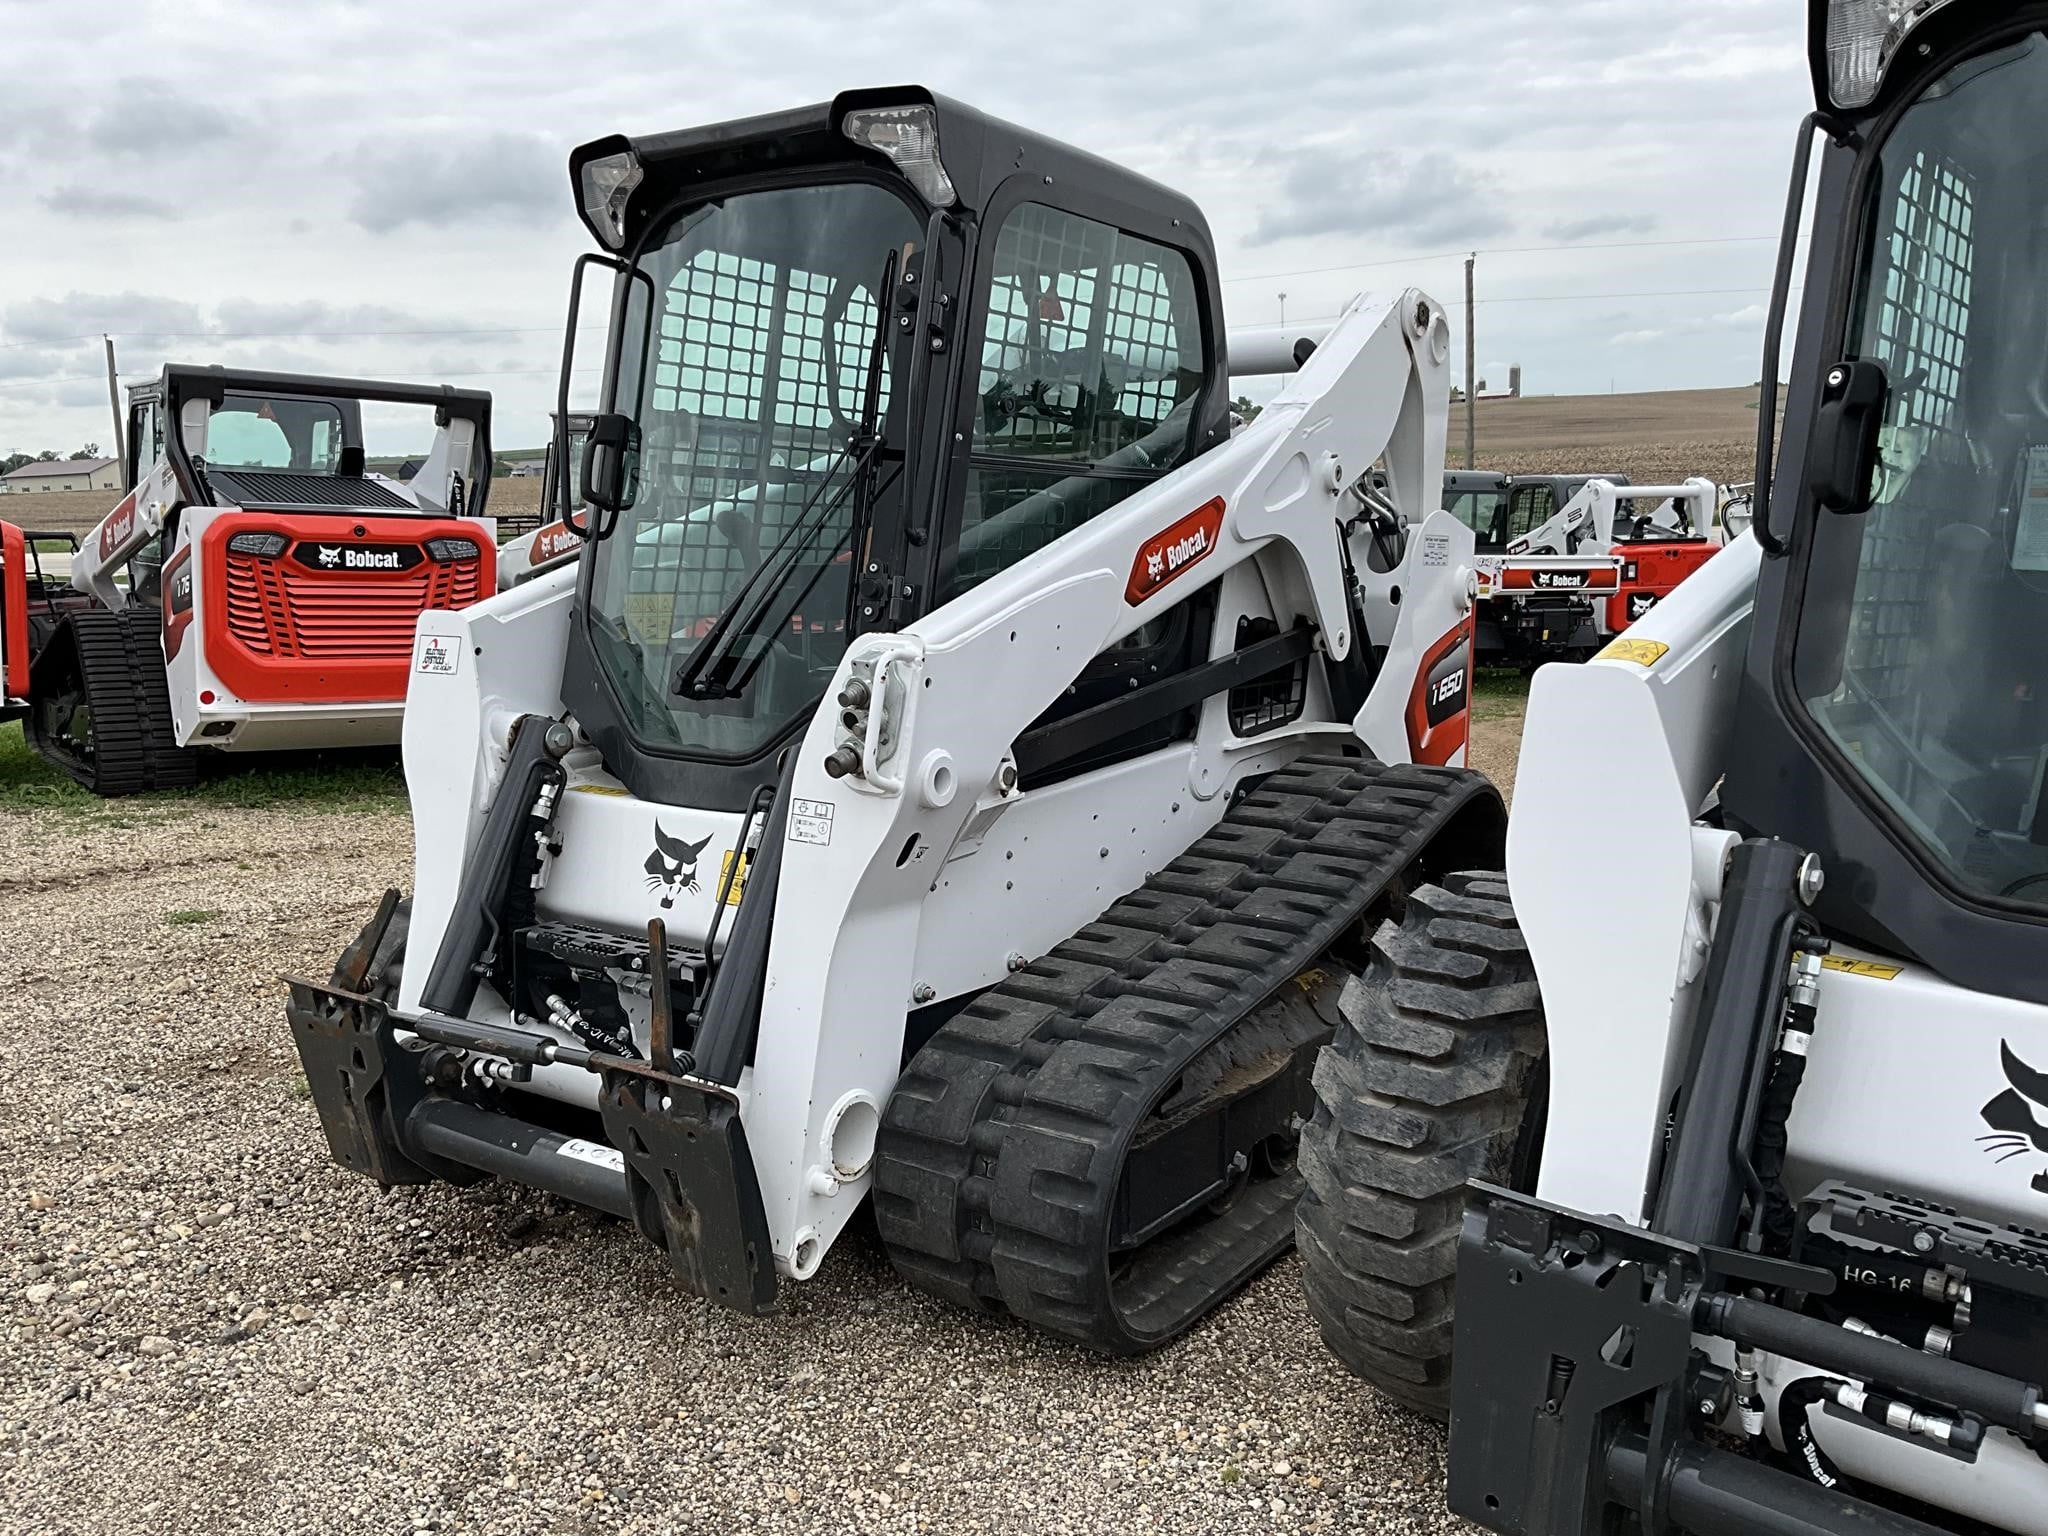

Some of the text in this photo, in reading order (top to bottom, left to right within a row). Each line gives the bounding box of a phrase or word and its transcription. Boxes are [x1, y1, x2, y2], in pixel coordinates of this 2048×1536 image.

[345, 550, 401, 568] Bobcat
[1166, 526, 1207, 571] Bobcat
[1552, 575, 1581, 587] Bobcat
[1844, 1264, 1911, 1292] HG-16
